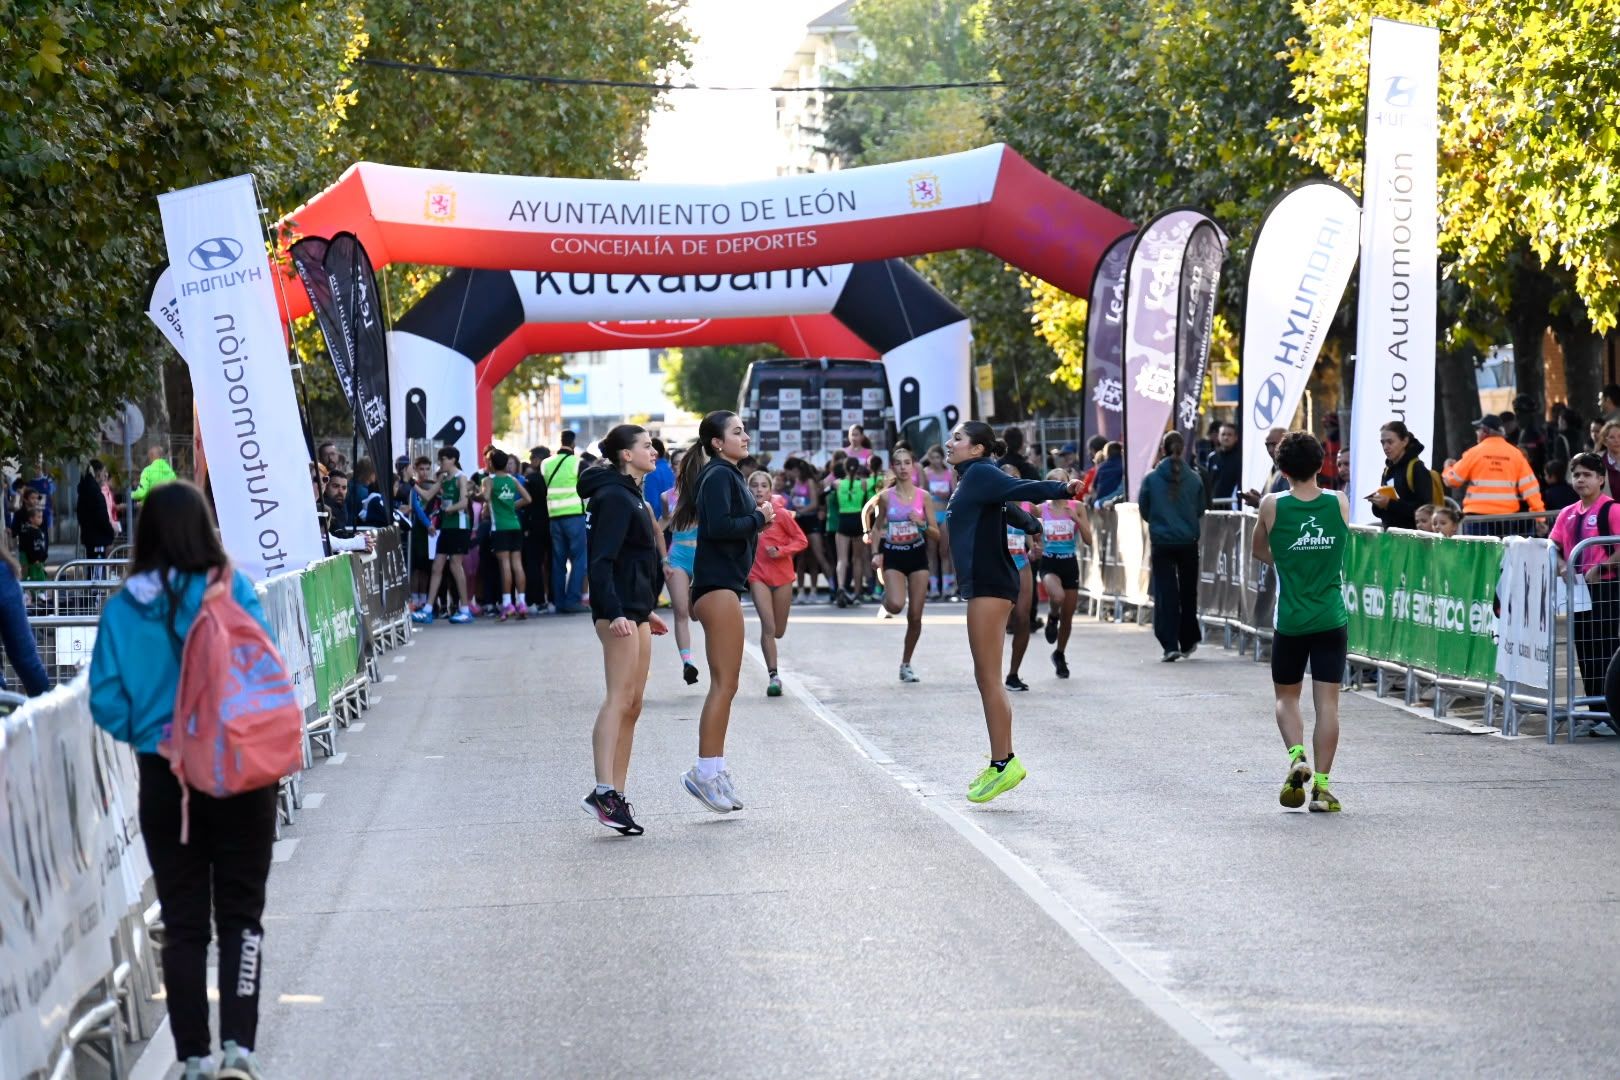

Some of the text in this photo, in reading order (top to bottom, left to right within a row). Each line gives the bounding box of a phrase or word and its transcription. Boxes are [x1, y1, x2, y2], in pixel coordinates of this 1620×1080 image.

[508, 187, 857, 226] AYUNTAMIENTO DE LEÓN
[550, 230, 818, 257] CONCEJALÍA DE DEPORTES
[1387, 152, 1413, 363] Automoción
[1273, 216, 1345, 367] HYUNDAI
[1296, 536, 1336, 547] SPRINT
[236, 928, 261, 997] Joma
